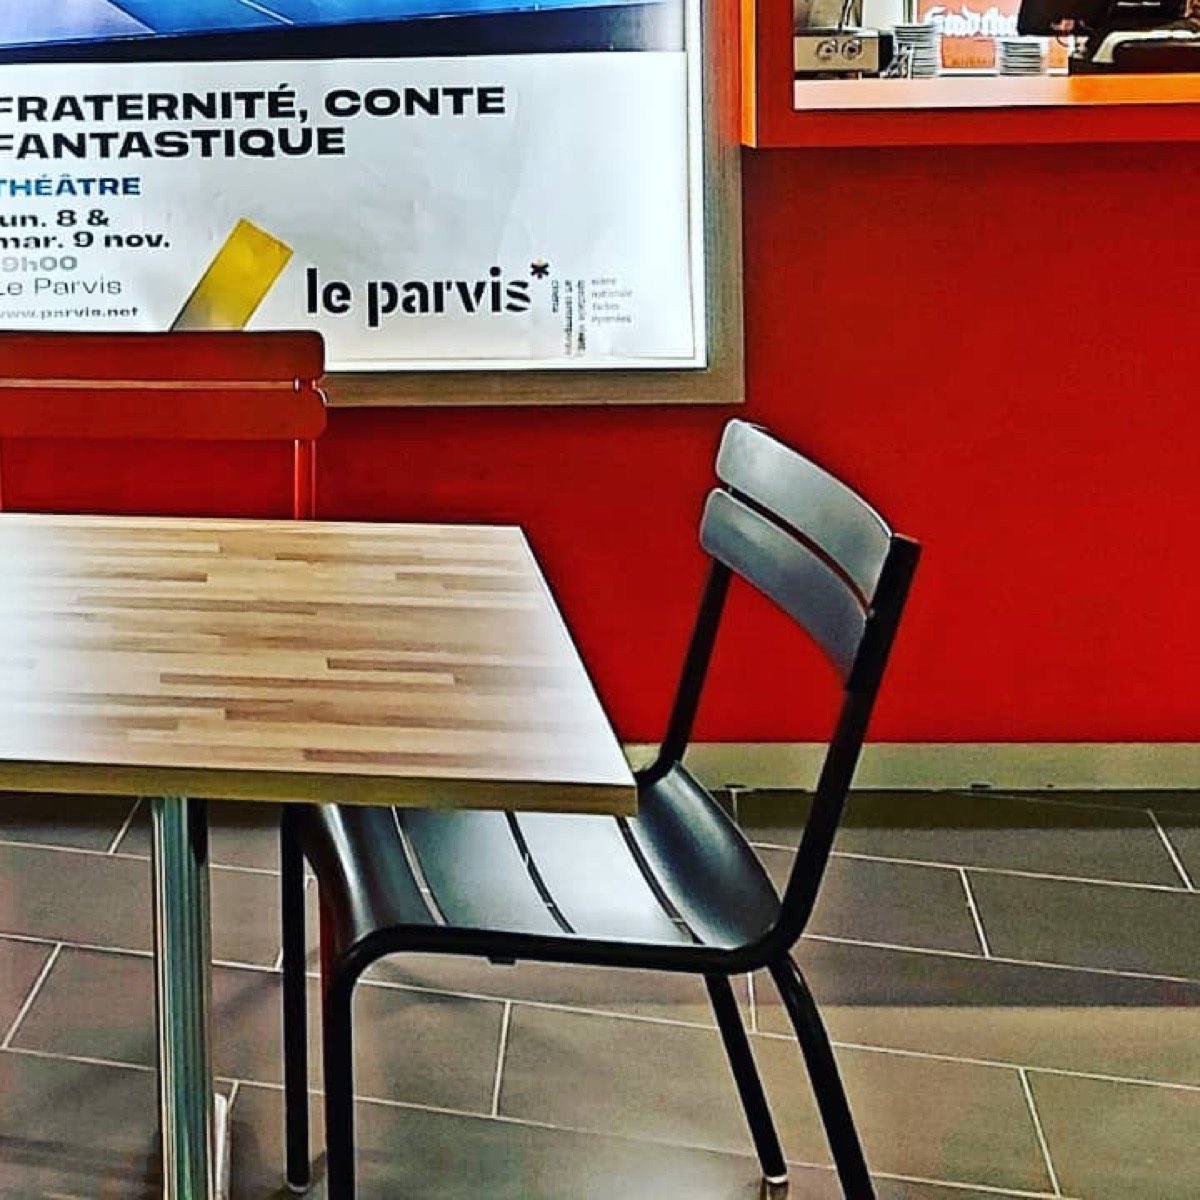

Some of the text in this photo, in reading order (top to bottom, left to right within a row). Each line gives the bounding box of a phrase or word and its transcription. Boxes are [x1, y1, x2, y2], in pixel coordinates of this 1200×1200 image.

[324, 87, 506, 117] CONTE
[56, 209, 77, 227] 8
[87, 208, 110, 227] &
[73, 231, 94, 248] 9
[104, 233, 170, 248] nov.
[34, 274, 122, 295] Parvis
[306, 267, 351, 314] le
